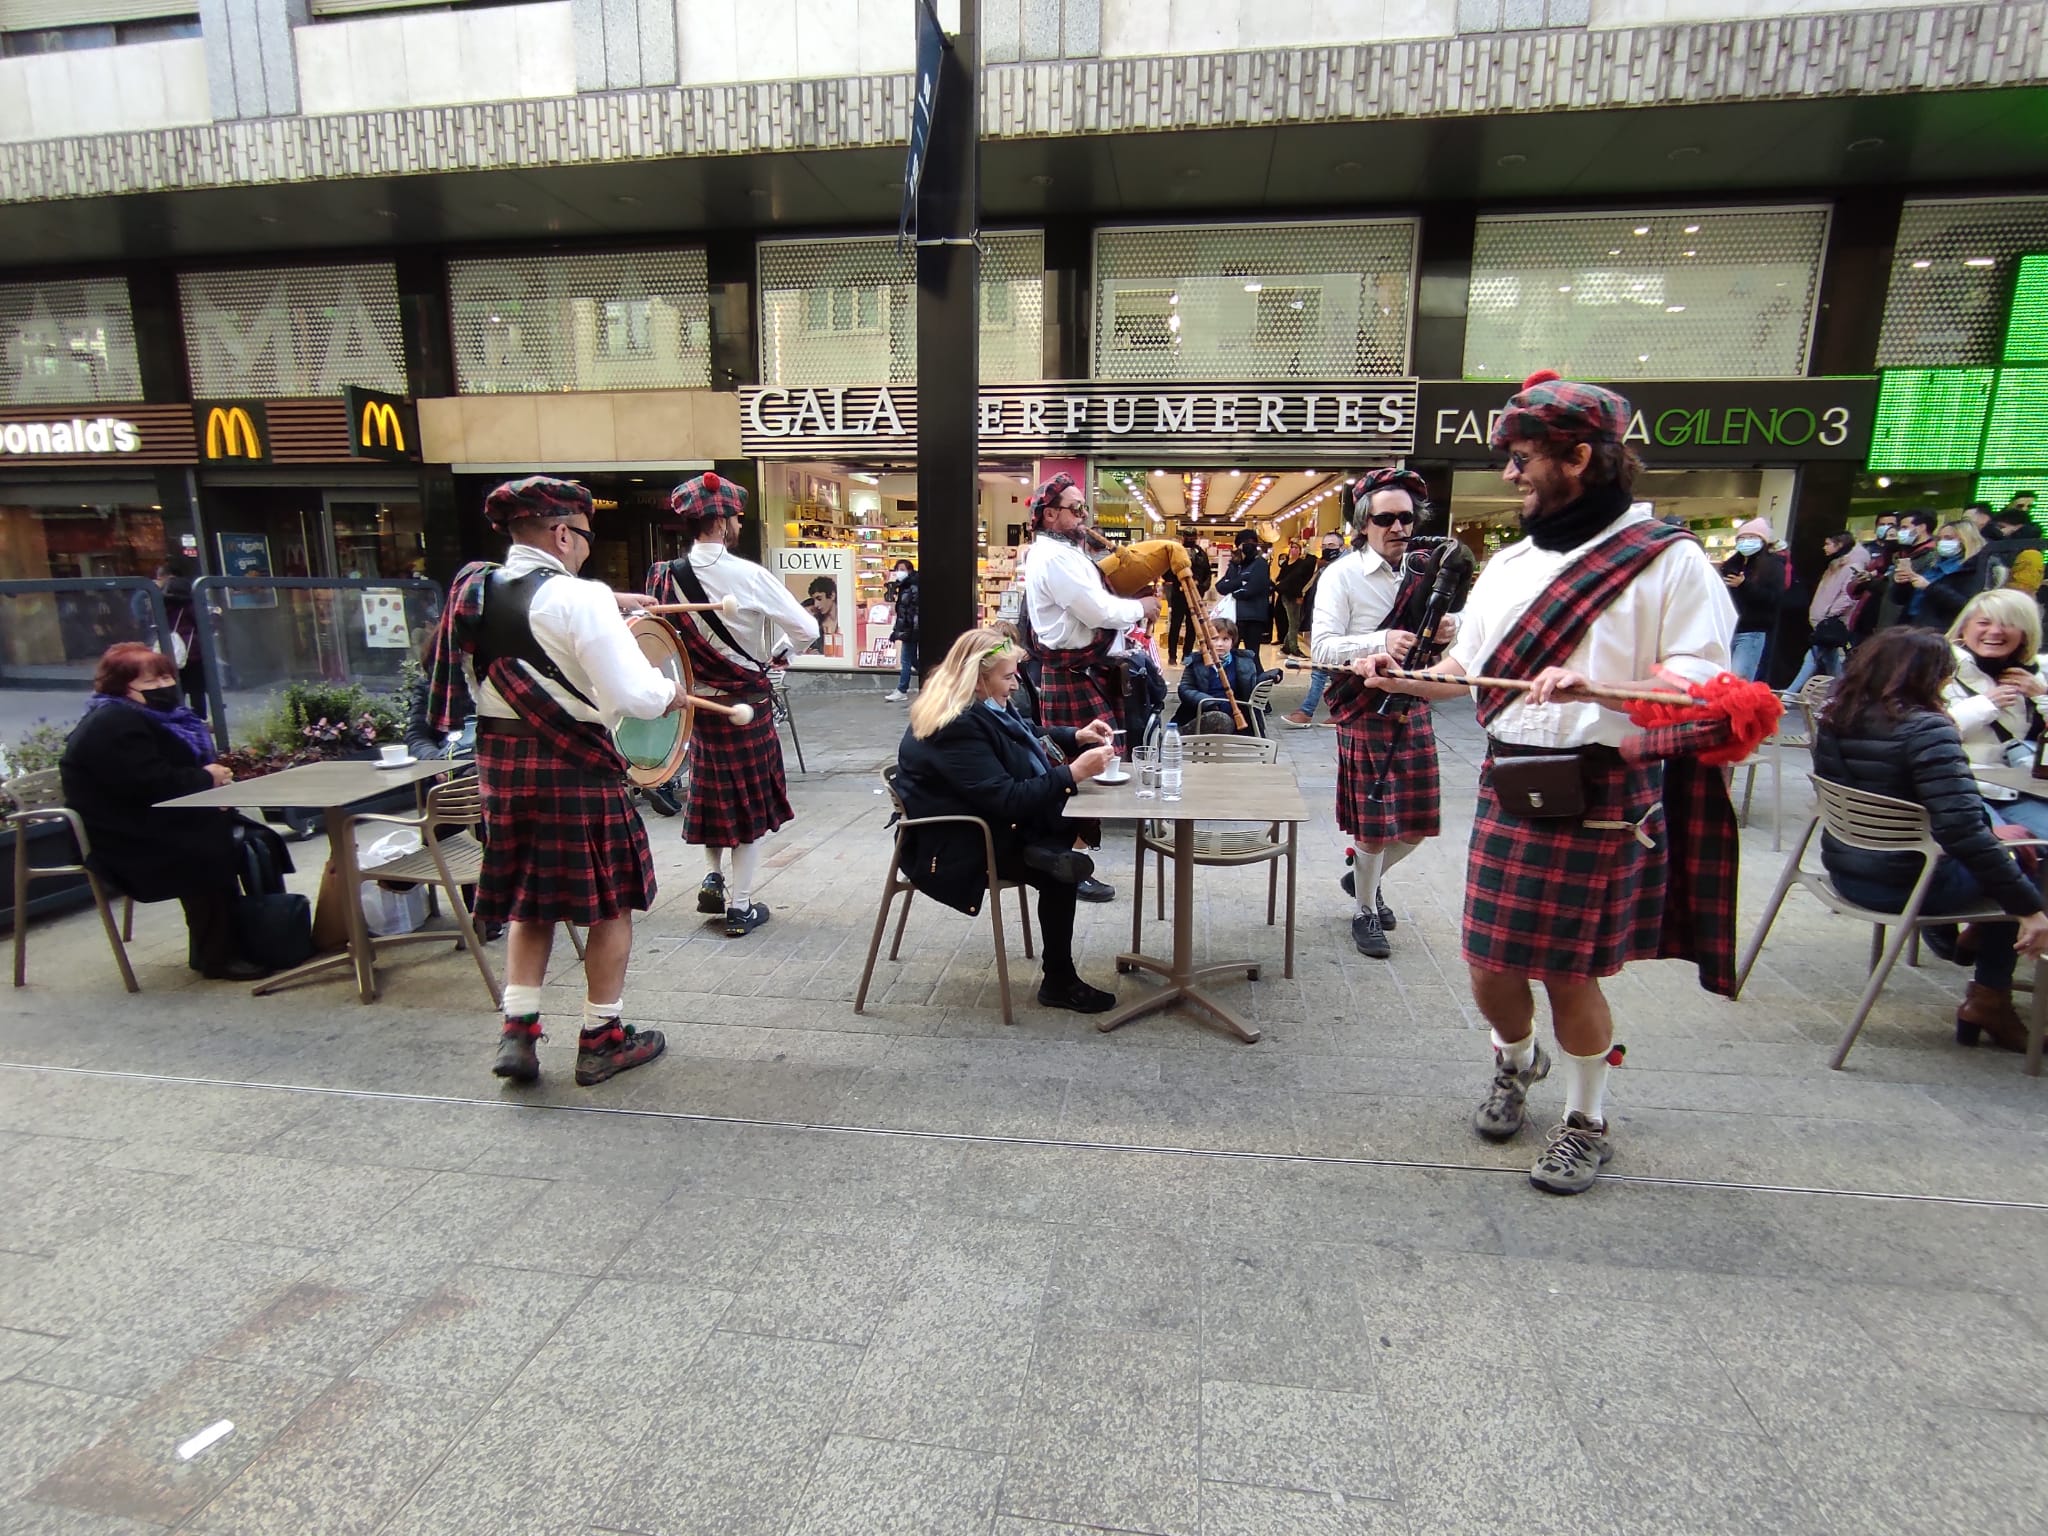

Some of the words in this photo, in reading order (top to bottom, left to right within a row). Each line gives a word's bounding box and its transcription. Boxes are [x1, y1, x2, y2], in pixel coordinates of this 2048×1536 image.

[750, 387, 906, 437] GALA
[978, 395, 1403, 434] ERFUMERIES
[1654, 407, 1817, 446] GALENO
[1818, 407, 1850, 446] 3
[0, 418, 142, 454] onald's
[779, 553, 843, 570] LOEWE
